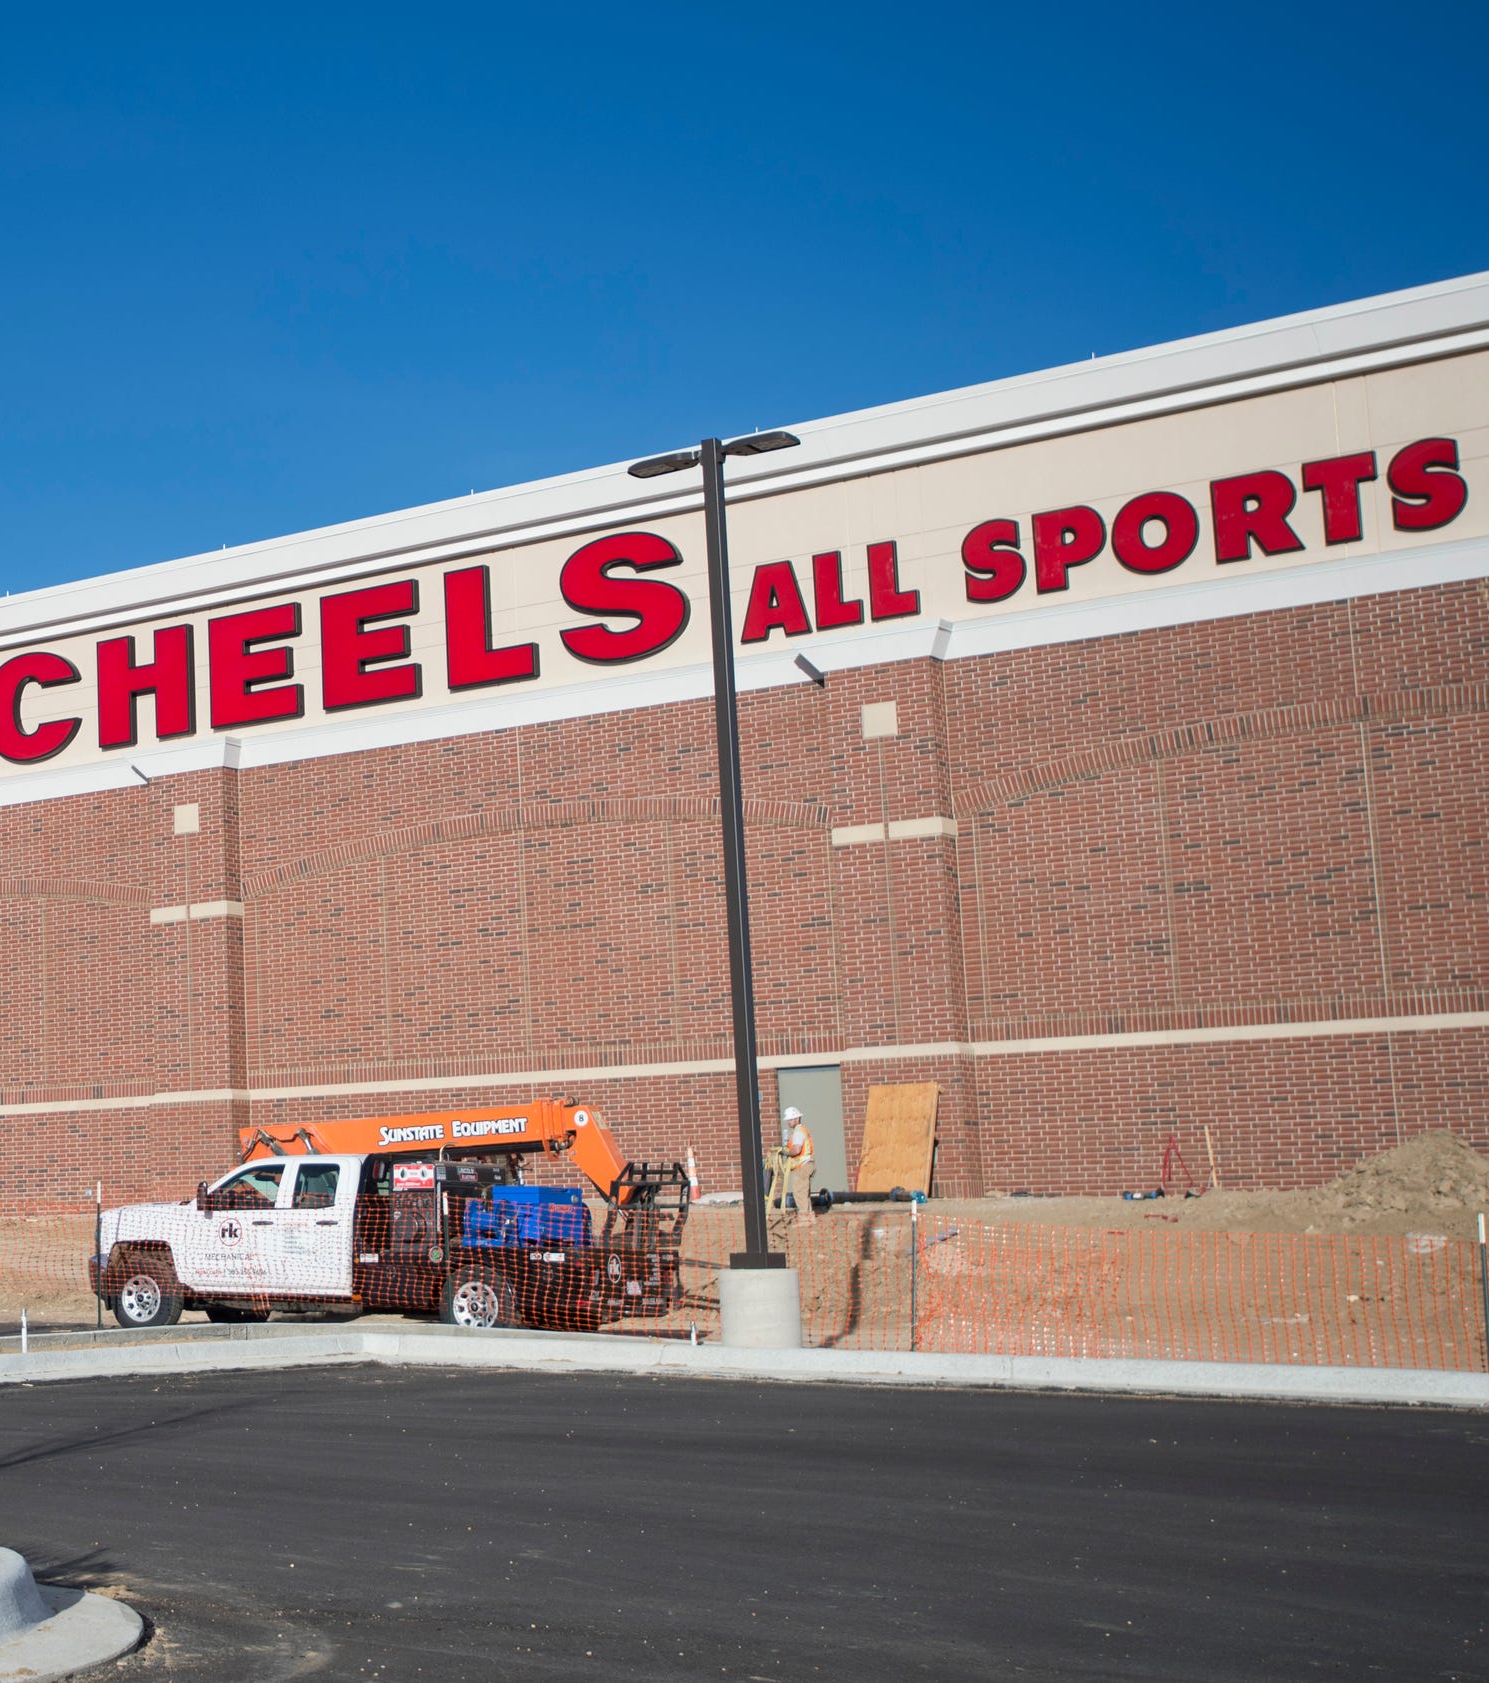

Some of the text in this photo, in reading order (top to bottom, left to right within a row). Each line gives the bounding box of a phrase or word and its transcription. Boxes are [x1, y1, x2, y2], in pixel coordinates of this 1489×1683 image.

[741, 540, 921, 643] ALL
[961, 437, 1469, 604] SPORTS
[378, 1117, 528, 1146] SUNSTATE EQUIPMENT
[221, 1222, 238, 1238] rk
[204, 1252, 255, 1261] MECHANICAL
